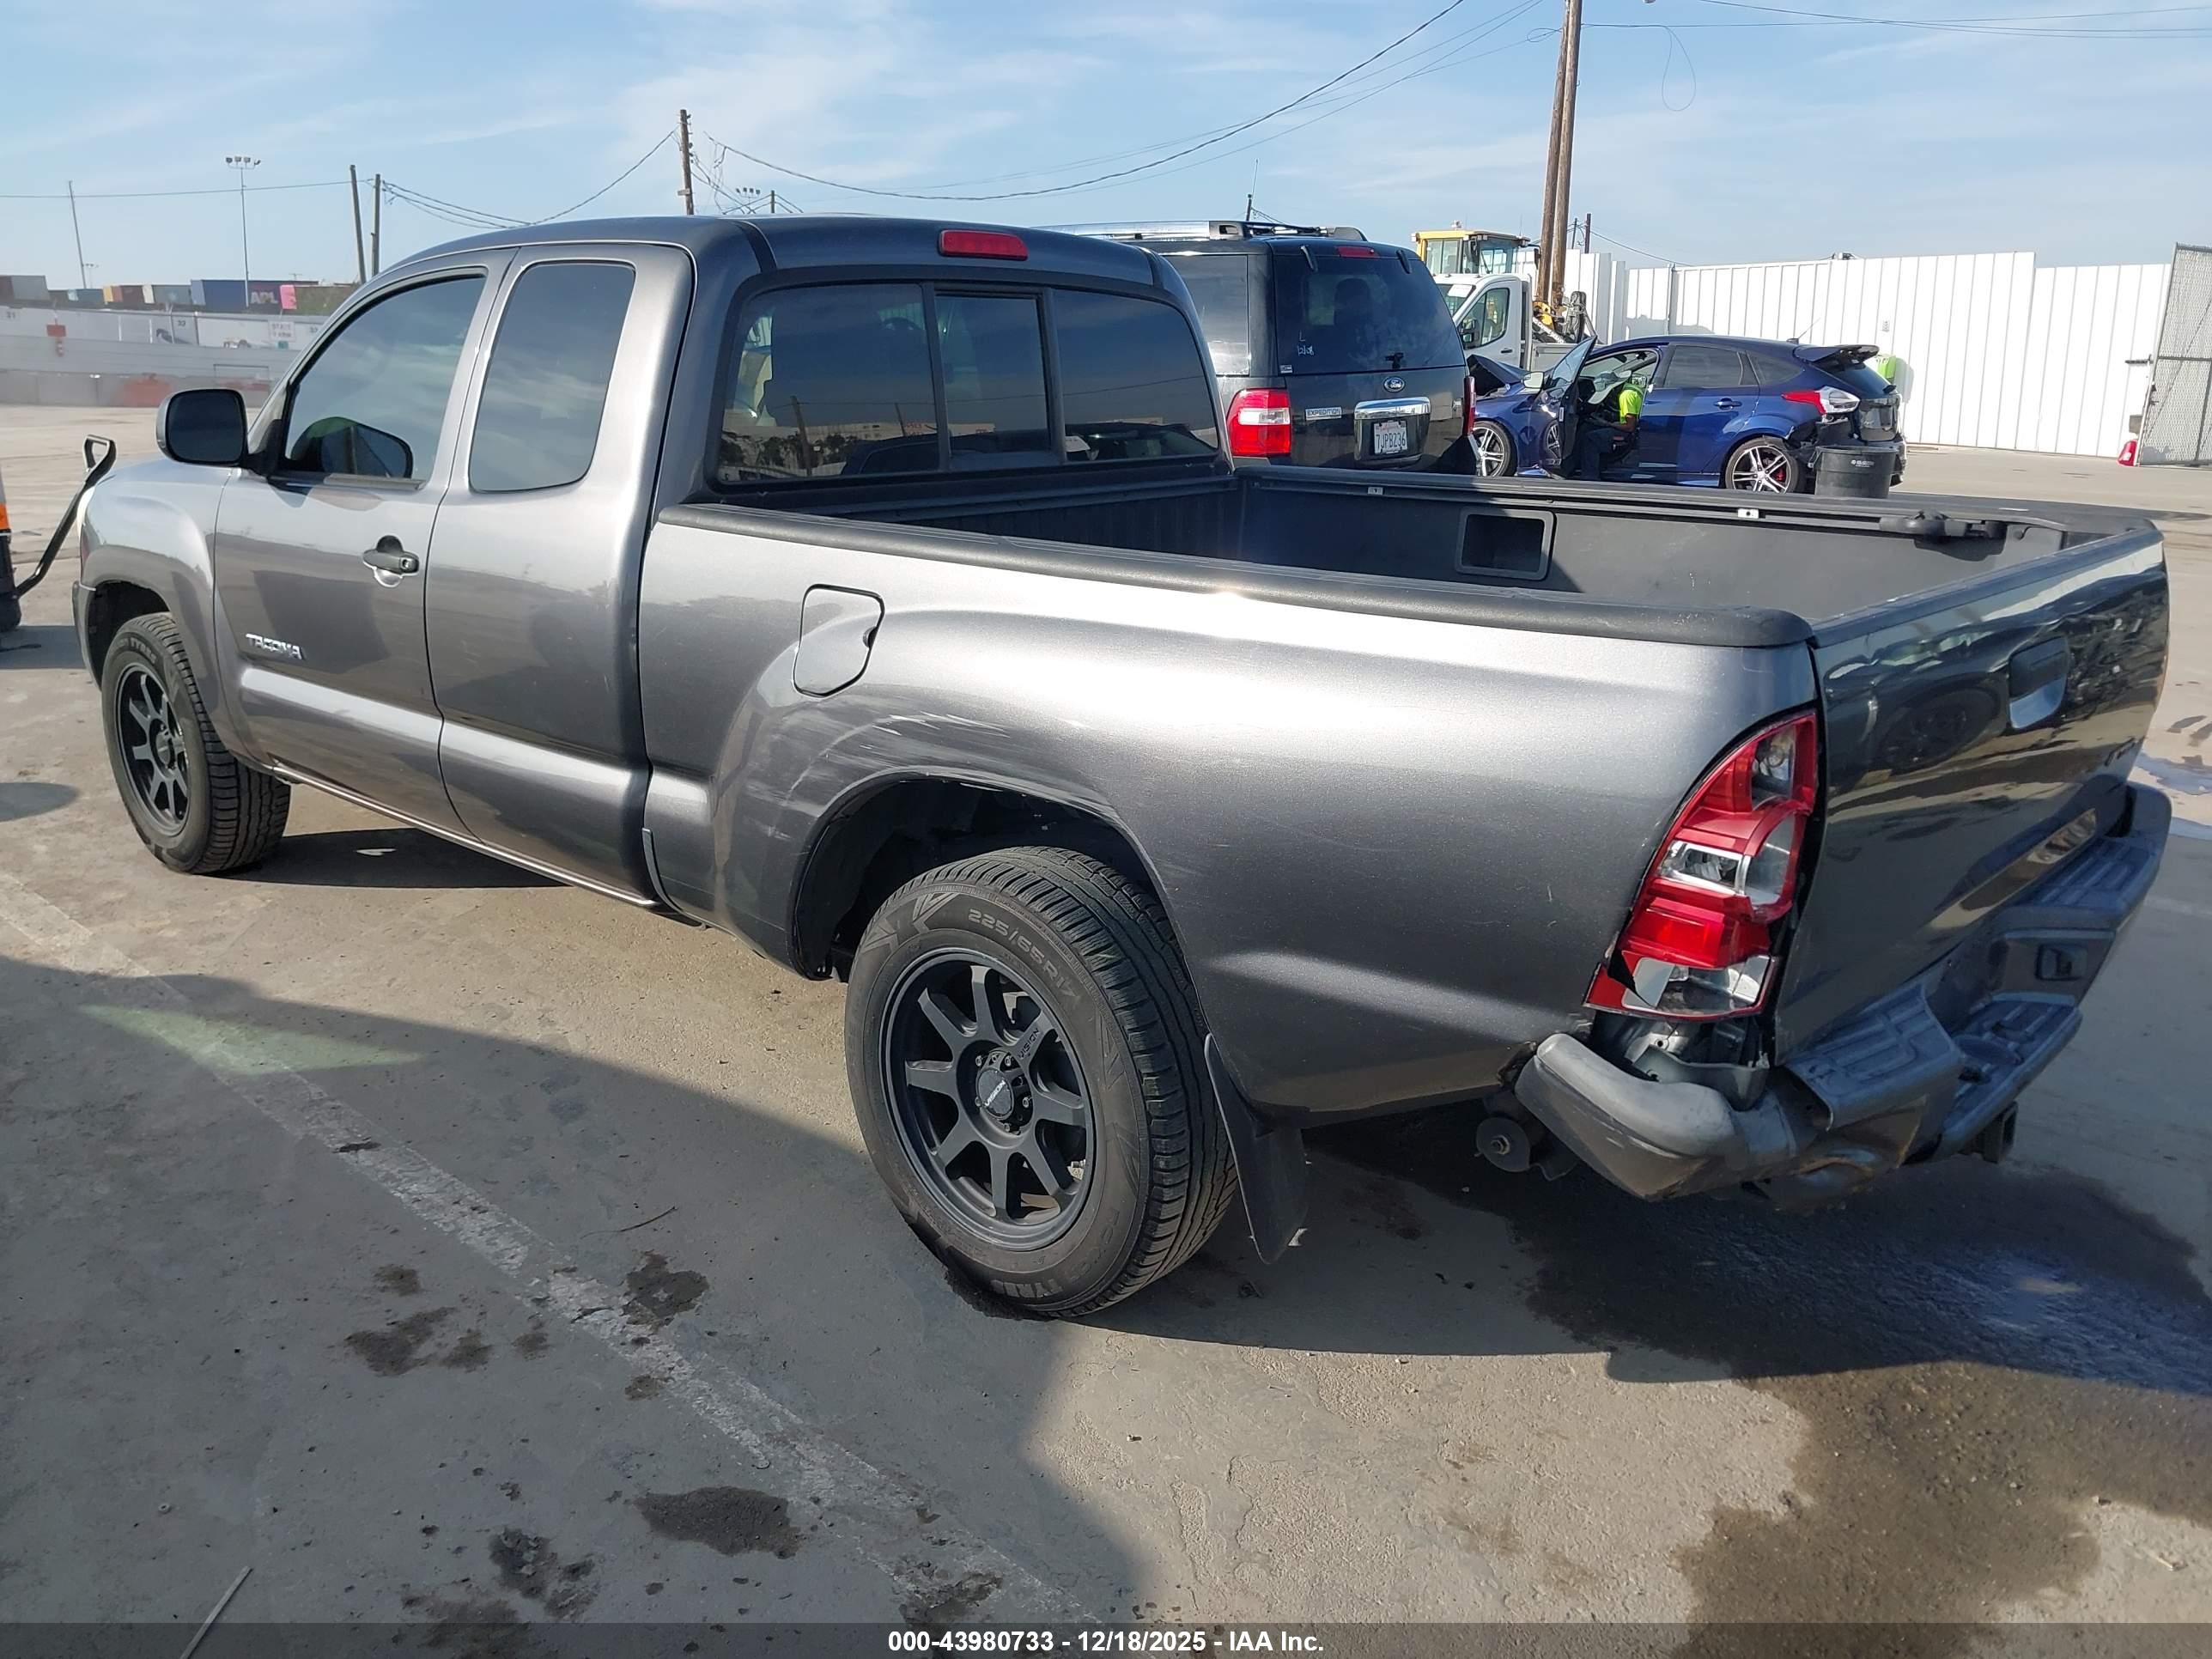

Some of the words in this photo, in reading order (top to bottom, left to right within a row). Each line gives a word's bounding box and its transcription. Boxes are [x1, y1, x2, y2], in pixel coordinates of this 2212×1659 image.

[250, 291, 279, 304] APL
[1376, 432, 1407, 449] 7JPB236
[246, 633, 304, 660] TACOMA
[1017, 1027, 1040, 1060] VISION
